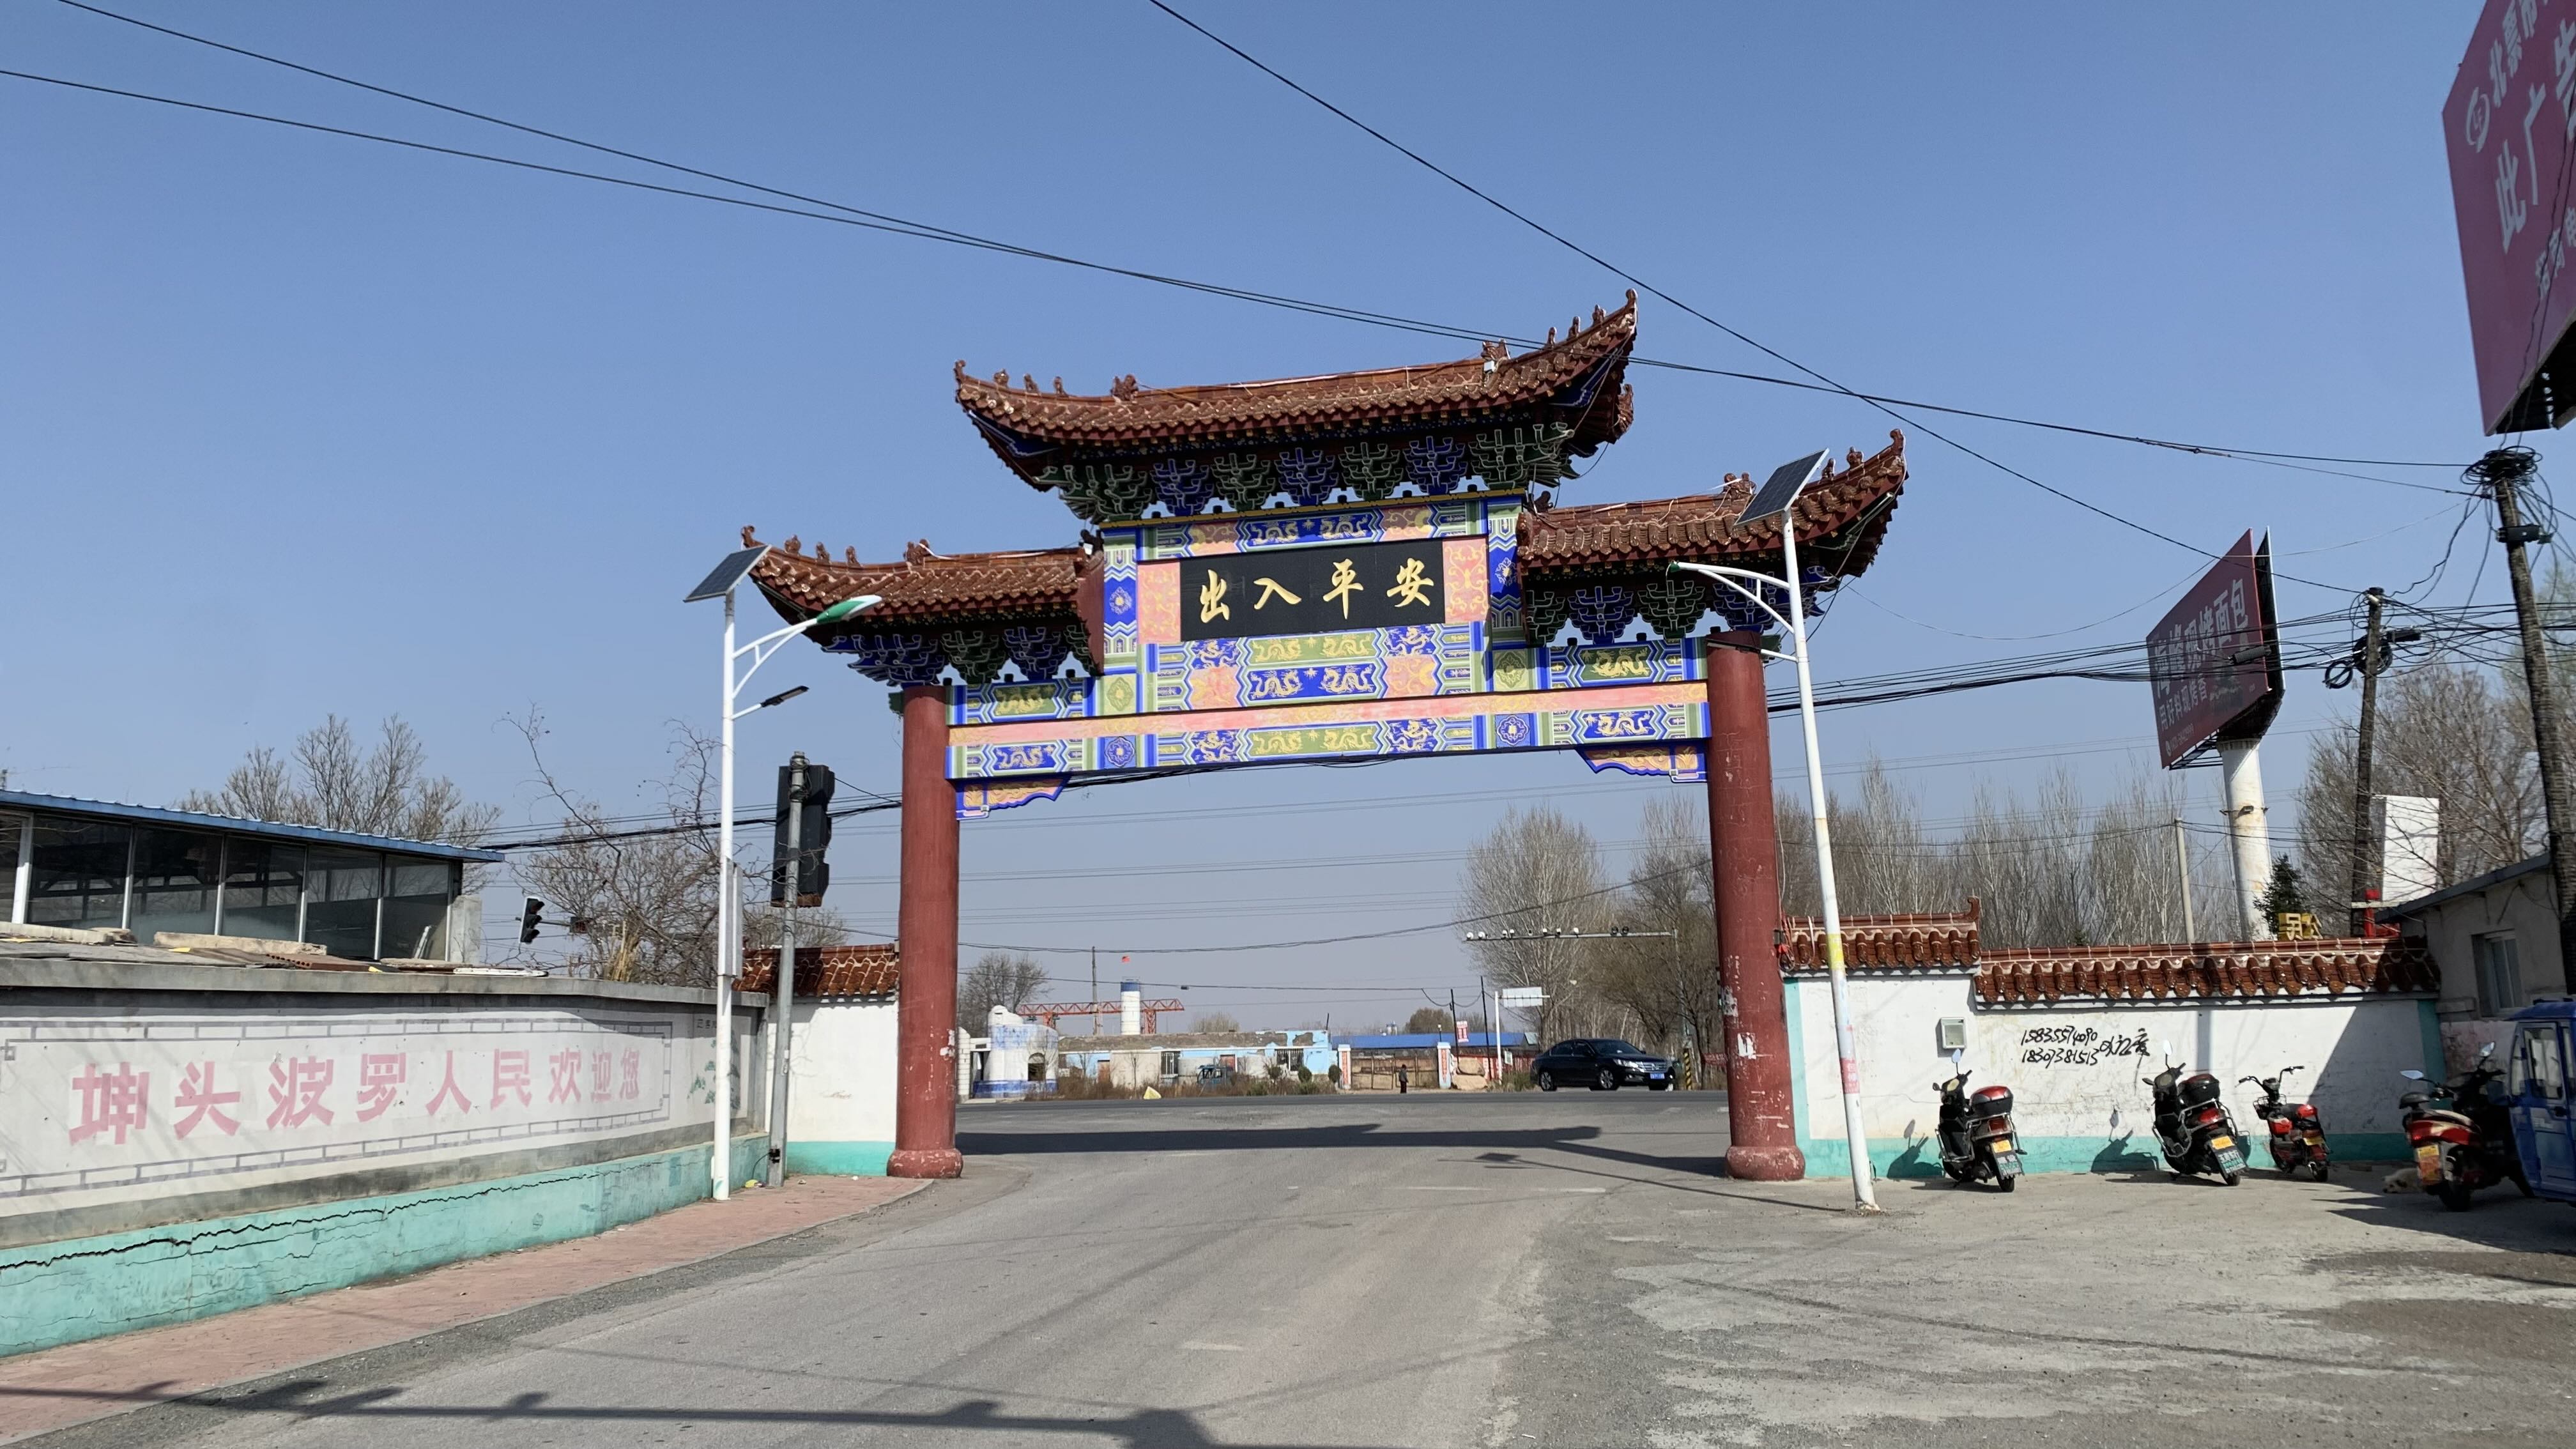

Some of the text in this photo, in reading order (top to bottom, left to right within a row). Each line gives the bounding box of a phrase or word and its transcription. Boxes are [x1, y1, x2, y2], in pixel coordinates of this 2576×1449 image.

[1200, 557, 1434, 623] 出入平安
[68, 1048, 640, 1145] 坤头波罗人民欢迎您
